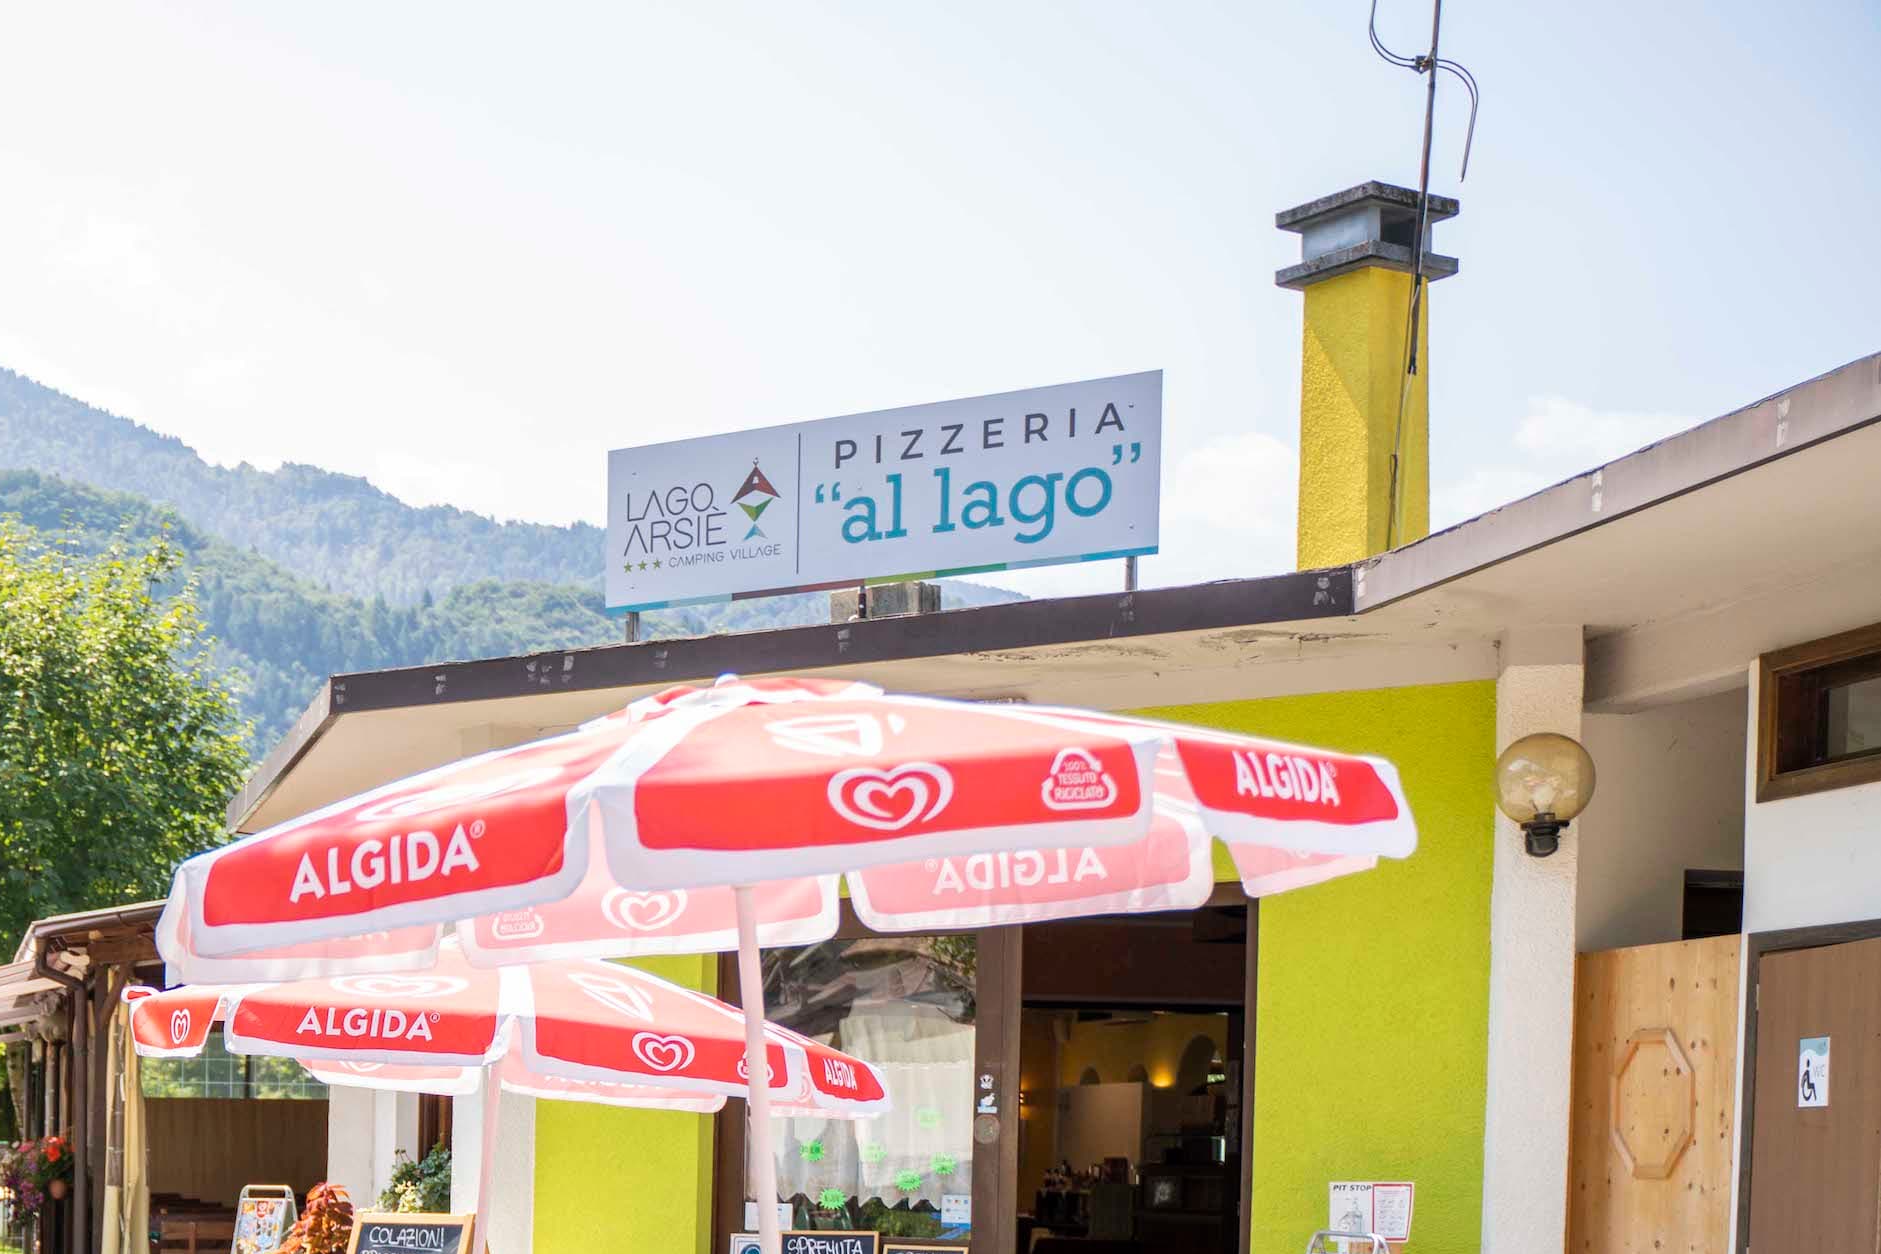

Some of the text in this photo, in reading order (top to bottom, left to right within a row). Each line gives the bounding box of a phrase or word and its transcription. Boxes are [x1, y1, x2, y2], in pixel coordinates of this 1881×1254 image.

[834, 402, 1125, 469] PIZZERIA
[627, 483, 714, 522] LAGO
[669, 544, 782, 568] CAMPING VILLAGE
